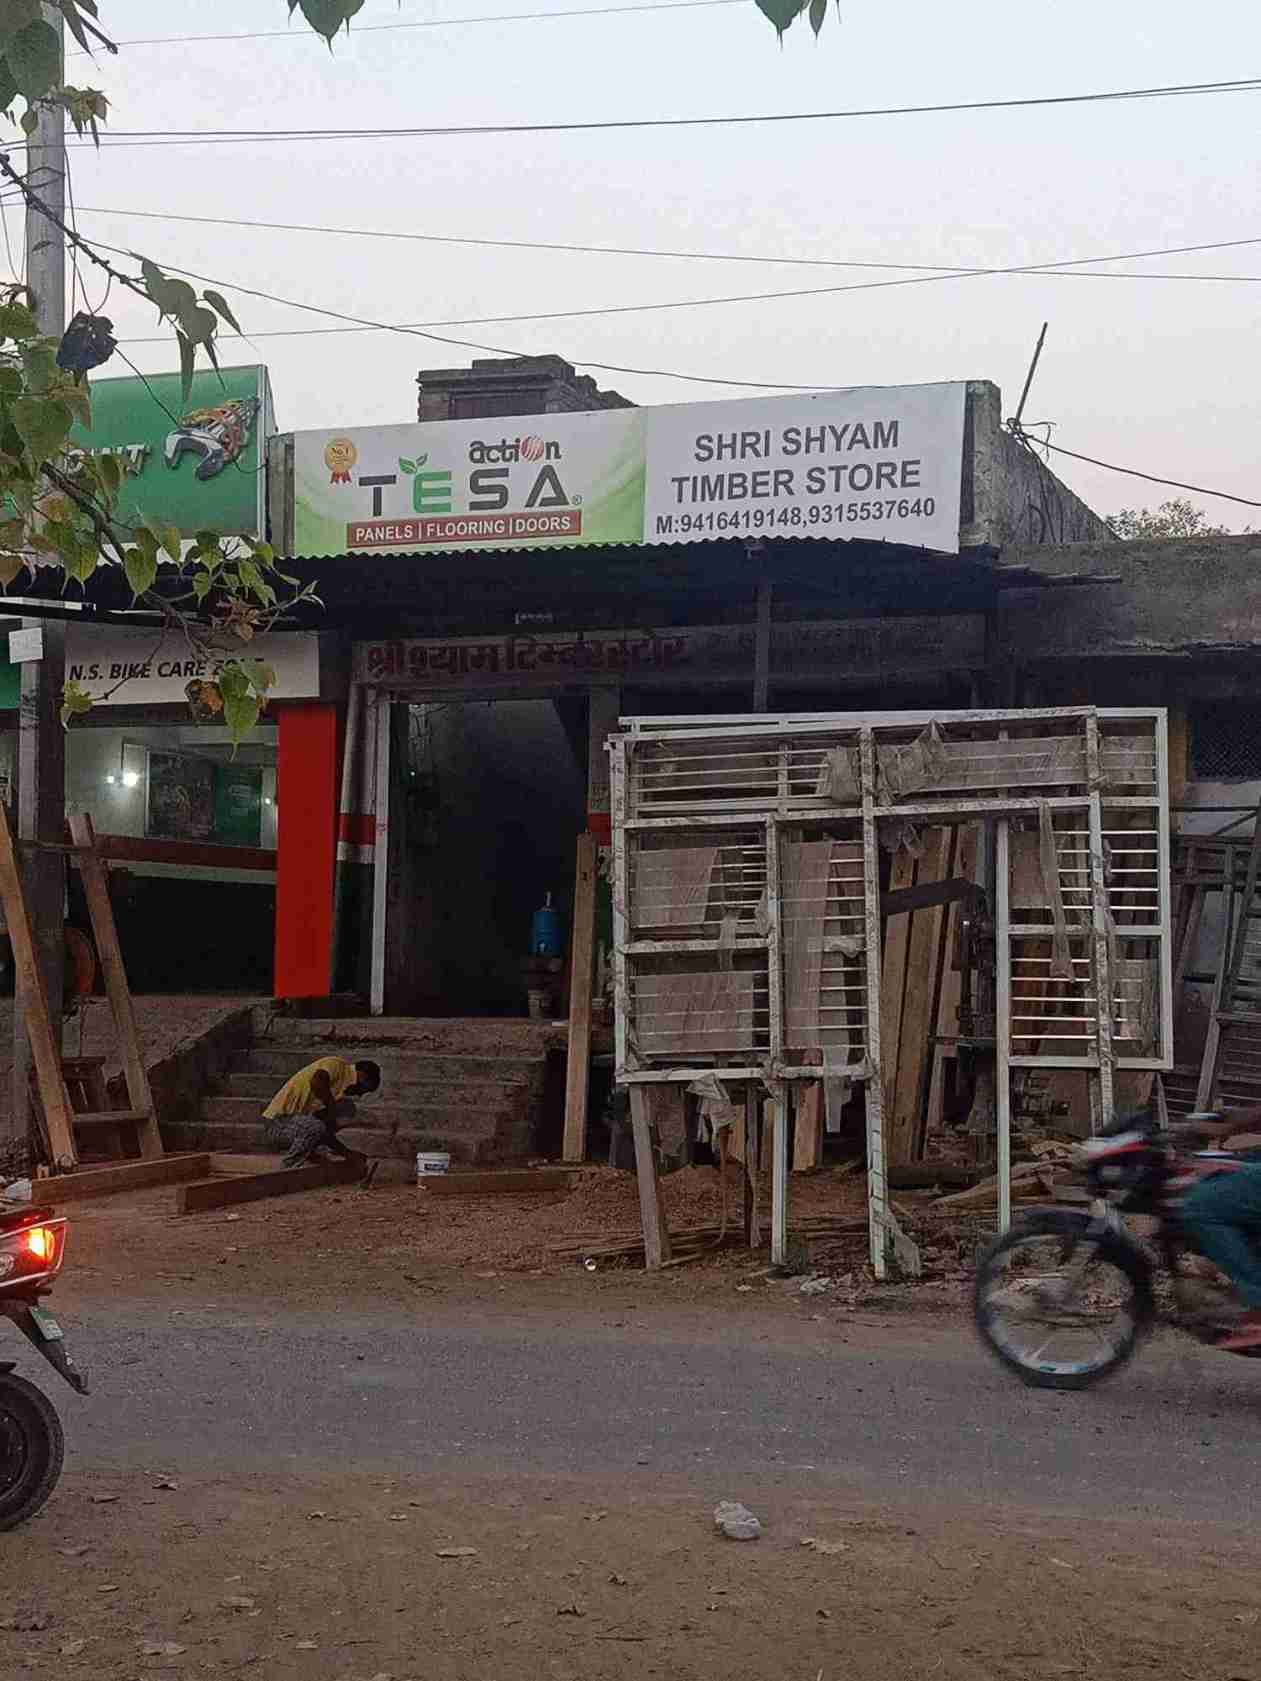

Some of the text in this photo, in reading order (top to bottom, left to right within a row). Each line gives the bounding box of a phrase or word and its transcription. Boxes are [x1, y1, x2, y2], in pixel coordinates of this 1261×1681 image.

[469, 436, 562, 464] action
[695, 420, 900, 463] SHRI SHYAM
[358, 464, 570, 518] TESA
[671, 459, 921, 504] TIMBER STORE
[355, 515, 571, 542] PANELS FLOORING DOORS
[656, 497, 936, 535] M:9416419148,9315537640
[69, 664, 103, 680] N.S.
[109, 663, 151, 679] BIKE
[157, 660, 206, 678] CARE
